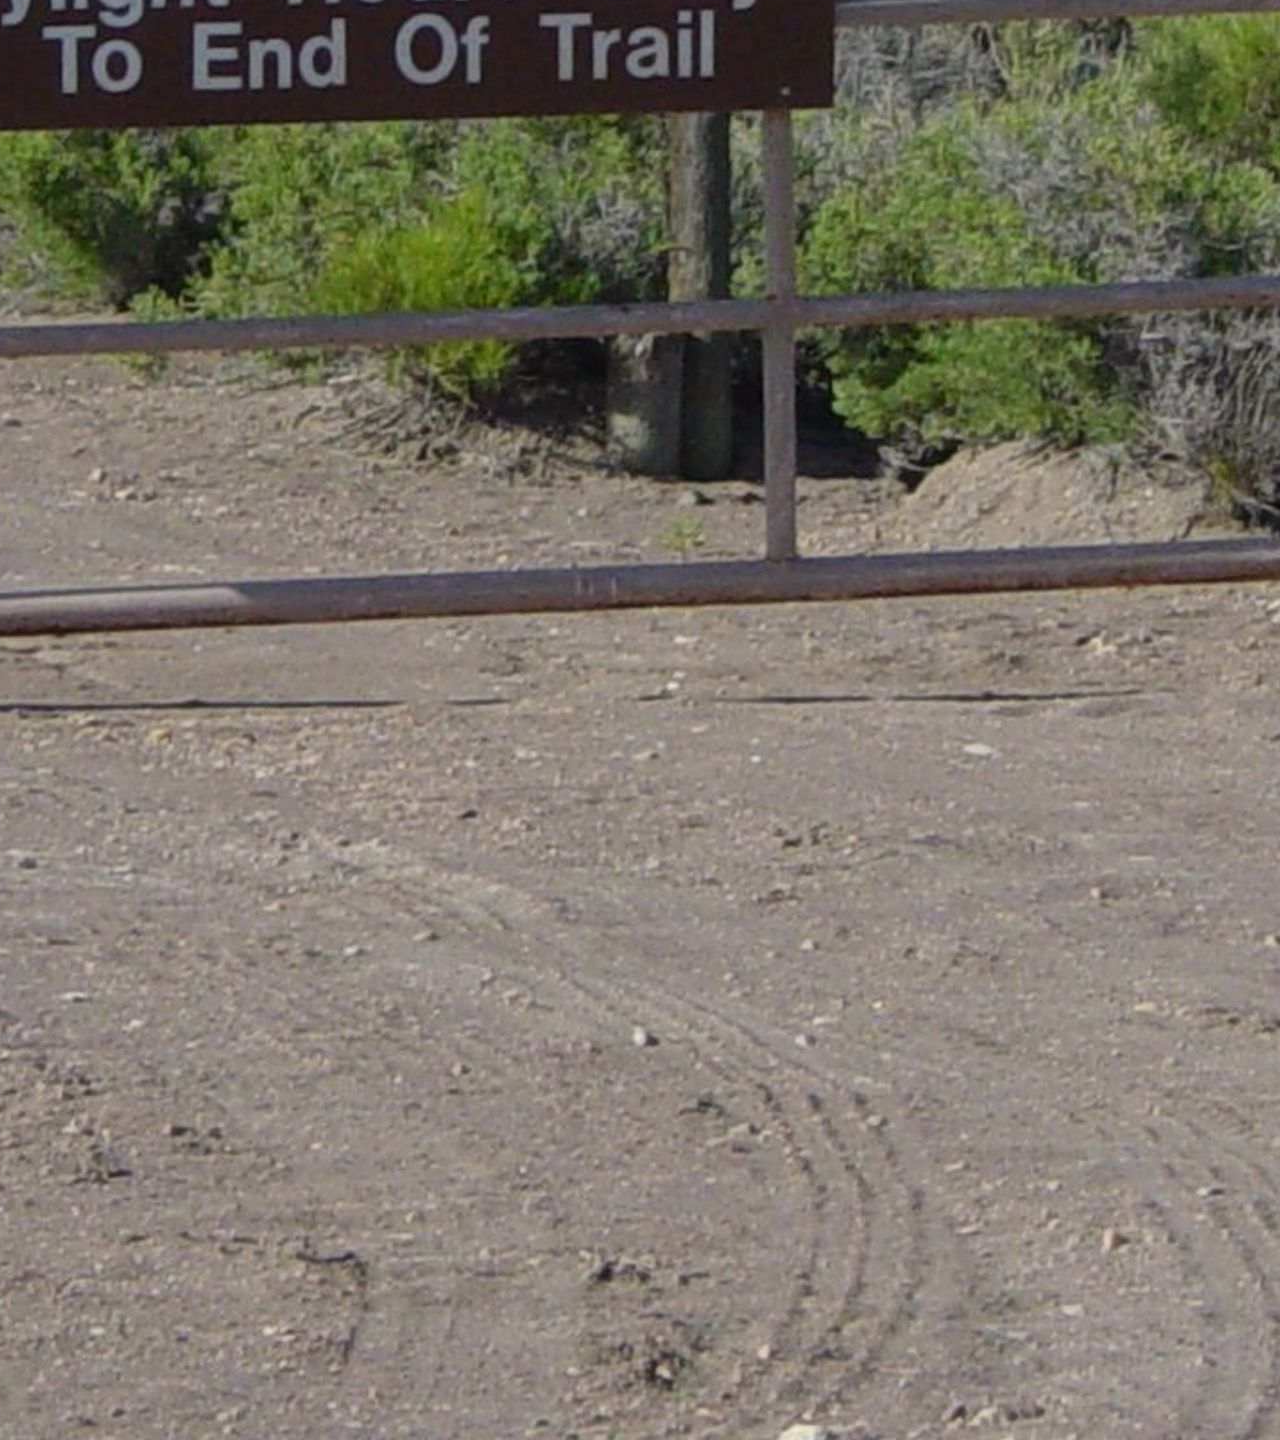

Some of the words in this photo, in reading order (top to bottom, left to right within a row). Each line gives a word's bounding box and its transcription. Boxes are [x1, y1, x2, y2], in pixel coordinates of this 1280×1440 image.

[43, 26, 142, 94] To
[193, 19, 346, 90] End
[395, 14, 490, 84] Of
[540, 10, 714, 80] Trail
